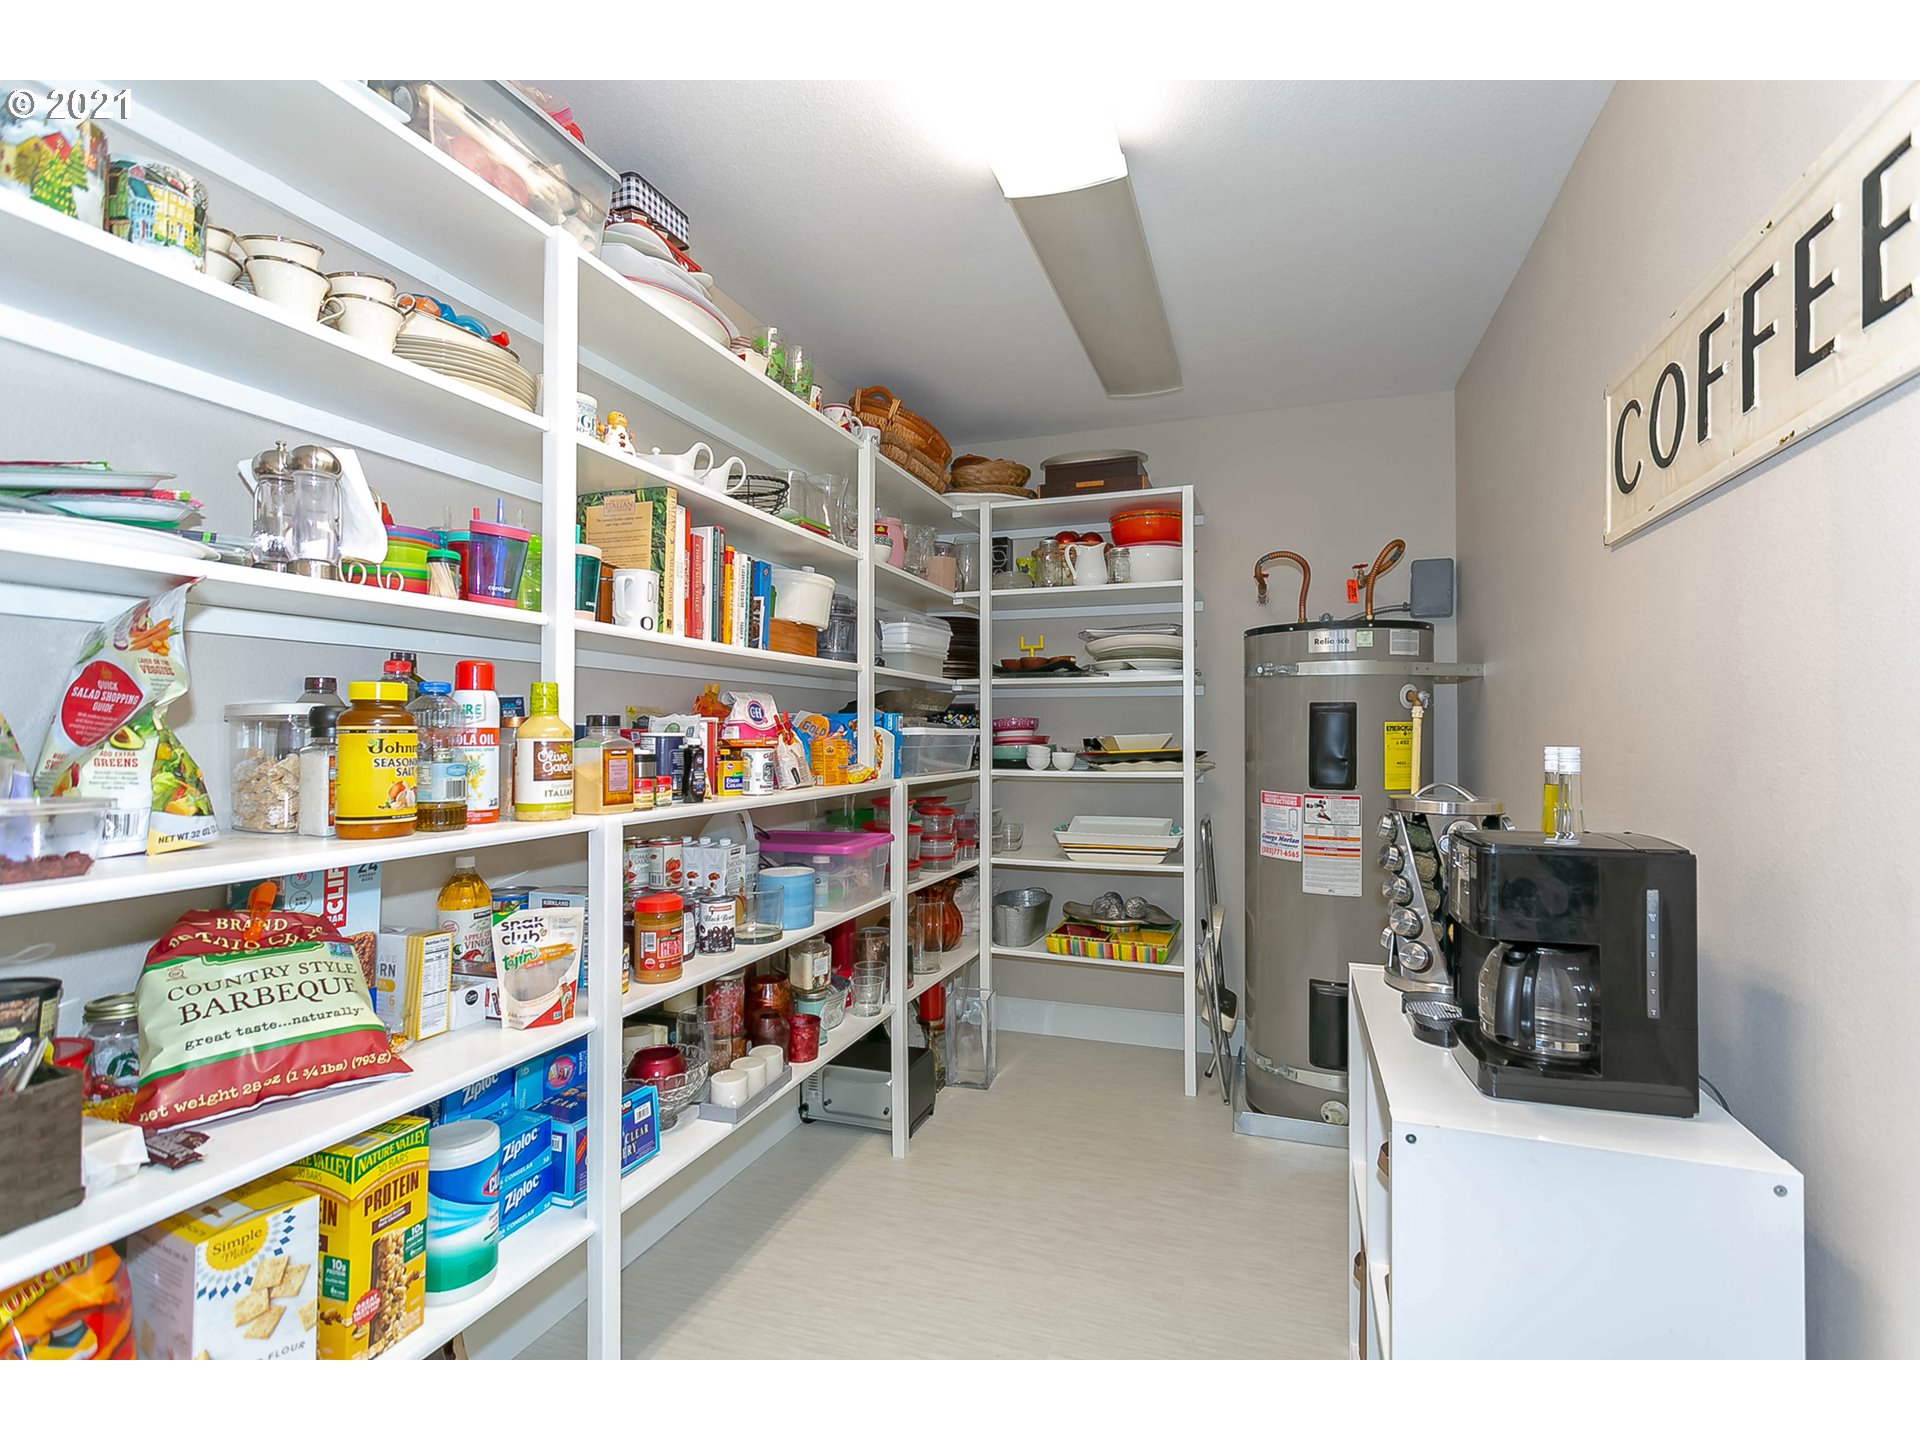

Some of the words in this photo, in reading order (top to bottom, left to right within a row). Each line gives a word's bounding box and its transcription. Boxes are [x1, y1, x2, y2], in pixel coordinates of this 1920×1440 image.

[1614, 130, 1916, 495] COFFEE
[488, 584, 511, 594] contigo
[97, 680, 119, 691] QUICK
[71, 687, 101, 700] SALAD
[101, 691, 140, 705] SHOPPING
[92, 701, 115, 713] GUIDE
[802, 720, 827, 737] GOLD
[479, 733, 496, 745] OIL
[93, 758, 139, 768] GREENS
[373, 757, 417, 768] SEASON
[537, 749, 568, 763] Olive
[158, 834, 175, 844] NET
[177, 832, 189, 841] WT
[500, 916, 545, 932] snak
[464, 932, 484, 941] APPLE
[464, 938, 492, 949] VINEG
[501, 929, 541, 946] club
[167, 963, 290, 1002] COUNTRY
[298, 960, 358, 975] STYLE
[178, 976, 359, 1026] BARBEQUE
[185, 1030, 232, 1050] great
[139, 1105, 169, 1123] net
[173, 1088, 239, 1114] weight
[625, 1124, 649, 1144] CLEAR
[357, 1141, 396, 1171] NATURE
[396, 1127, 428, 1151] VALLEY
[502, 1127, 538, 1166] Ziploc
[312, 1155, 351, 1180] VALLEY
[377, 1162, 388, 1176] 30
[388, 1152, 409, 1172] BARS
[505, 1162, 534, 1183] CONGELAR
[364, 1170, 419, 1217] PROTEIN
[504, 1174, 540, 1214] Ziploc
[506, 1209, 535, 1231] CONGELAR
[212, 1228, 263, 1256] Simple
[221, 1244, 255, 1264] Mills
[331, 1258, 347, 1272] 10g
[268, 1340, 306, 1360] FLOUR
